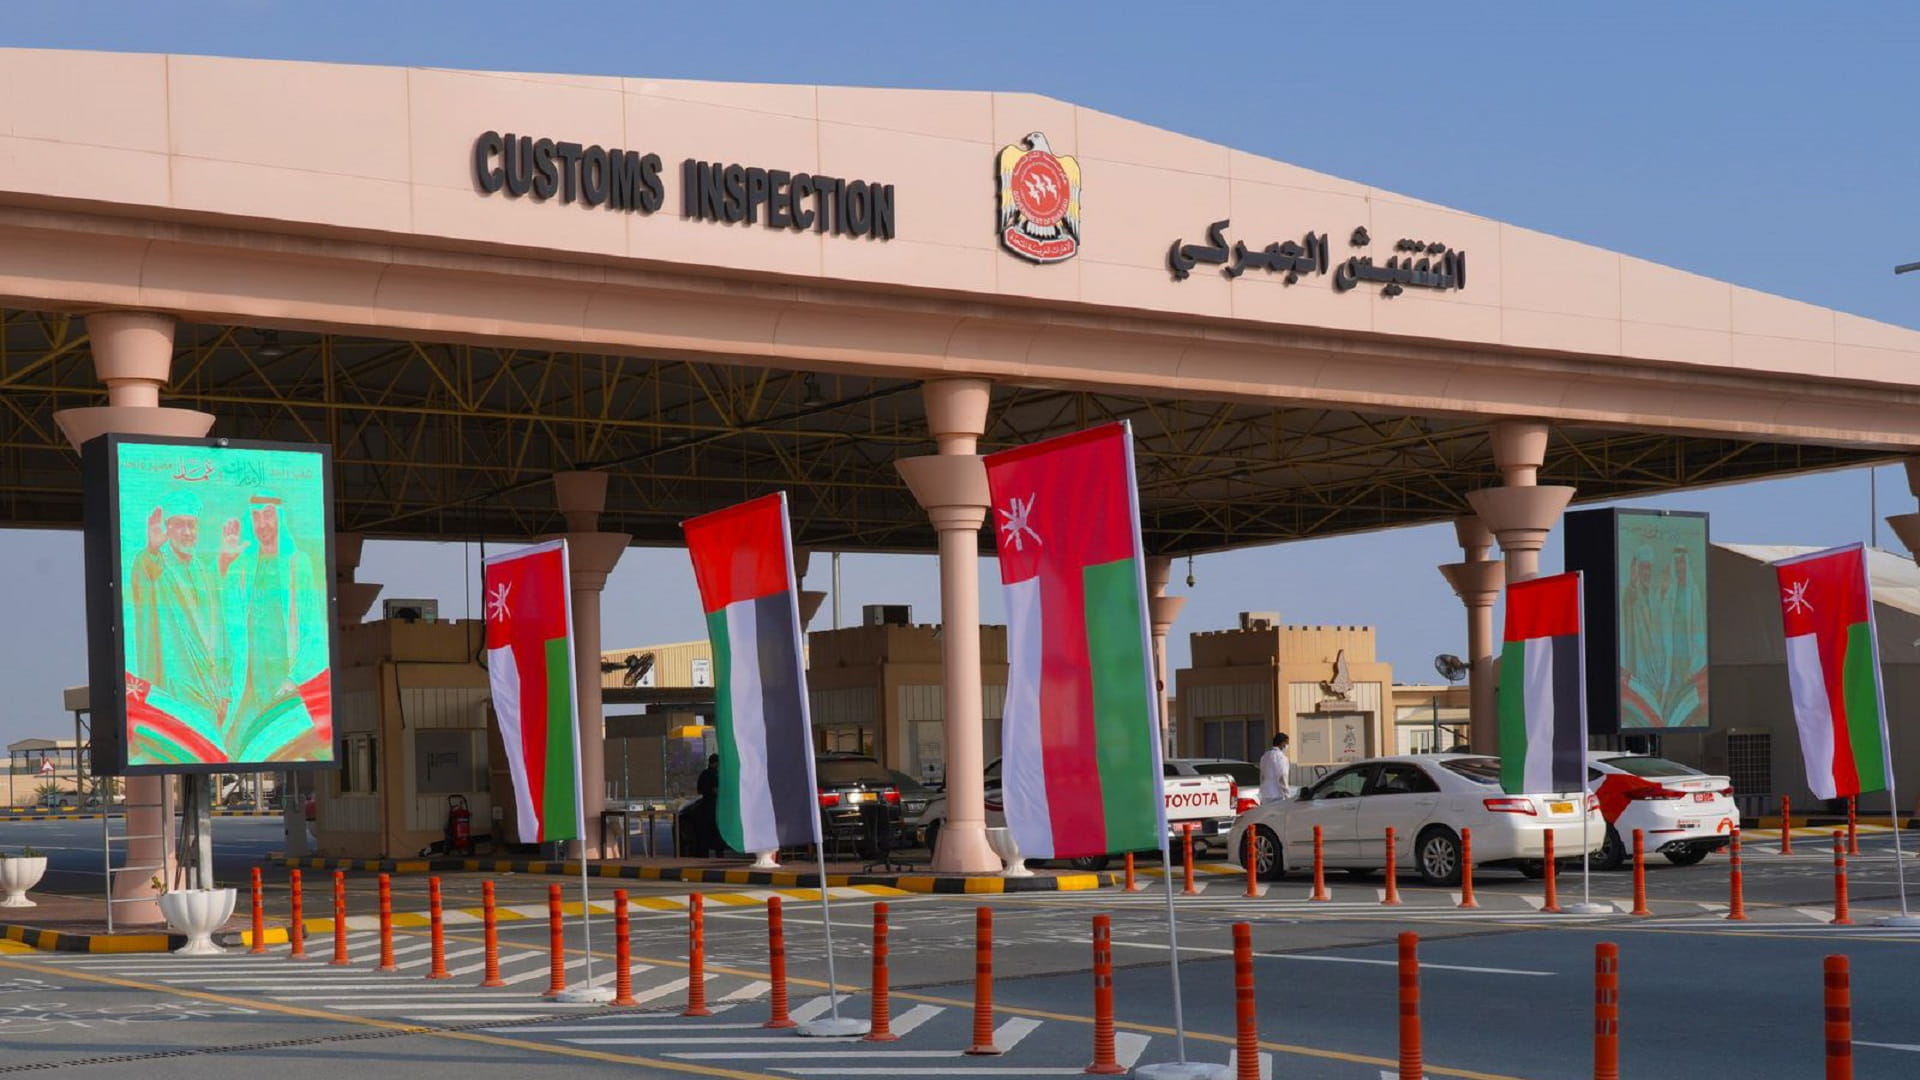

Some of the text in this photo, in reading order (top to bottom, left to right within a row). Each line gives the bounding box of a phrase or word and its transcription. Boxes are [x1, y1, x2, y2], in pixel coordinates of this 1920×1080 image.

[475, 130, 896, 240] CUSTOMS INSPECTION
[1168, 219, 1466, 297] التفتيش الجمركي
[1164, 792, 1219, 809] TOYOTA
